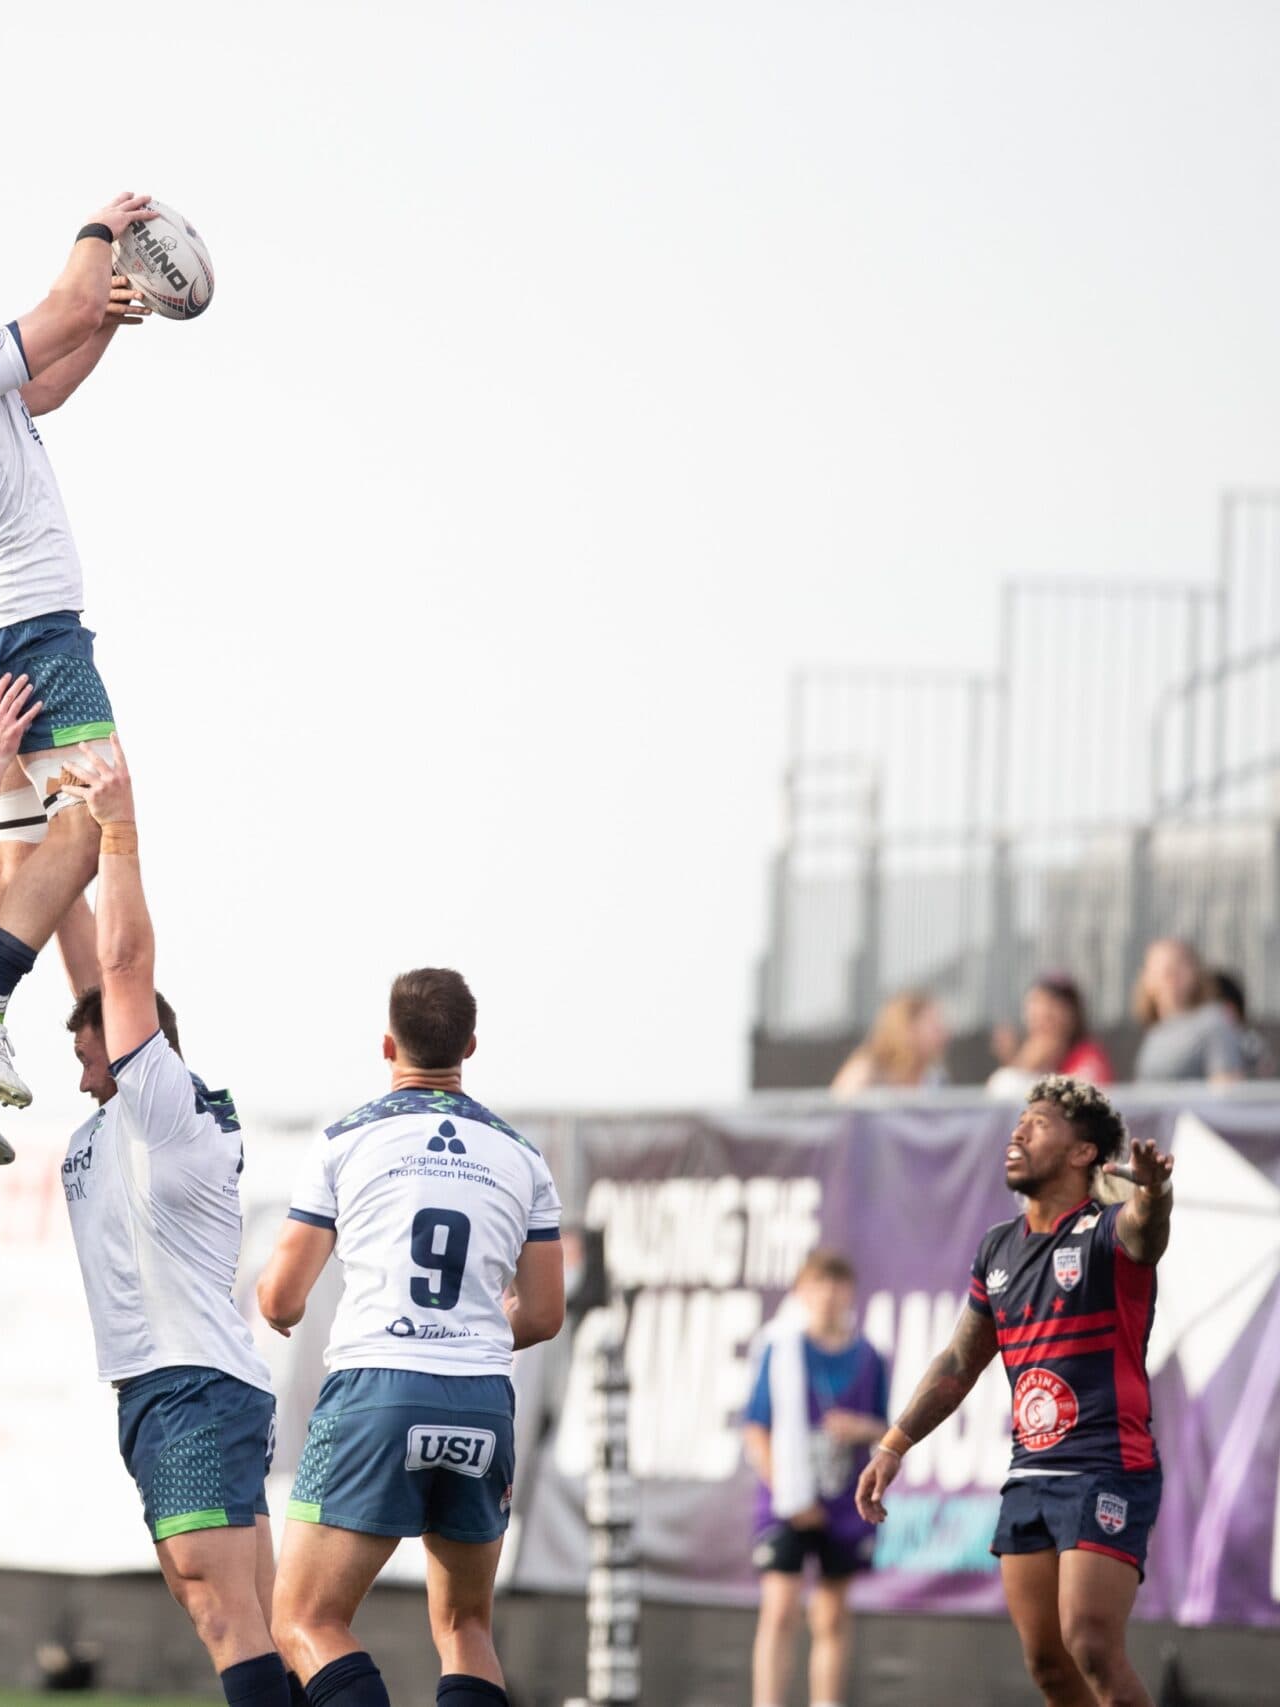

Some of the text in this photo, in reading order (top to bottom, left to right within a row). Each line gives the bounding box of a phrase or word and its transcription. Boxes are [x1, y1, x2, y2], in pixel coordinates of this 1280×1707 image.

[61, 1146, 92, 1173] afd
[401, 1155, 491, 1175] Virginia Mason
[64, 1176, 87, 1201] ank
[388, 1166, 497, 1189] Franciscan Health
[410, 1207, 471, 1311] 9
[420, 1434, 486, 1467] USI
